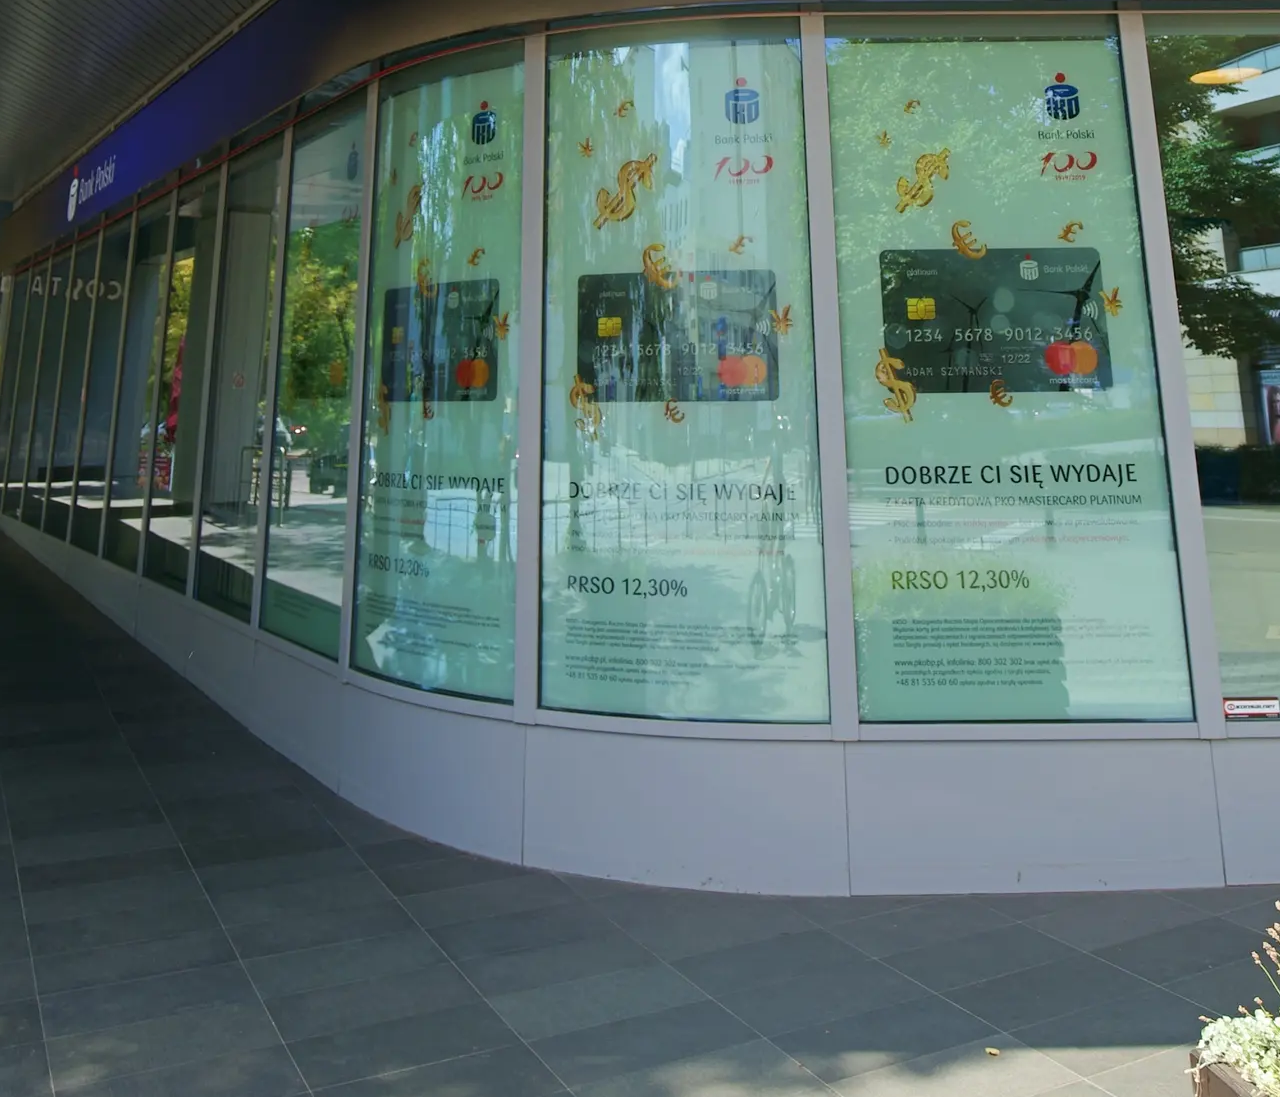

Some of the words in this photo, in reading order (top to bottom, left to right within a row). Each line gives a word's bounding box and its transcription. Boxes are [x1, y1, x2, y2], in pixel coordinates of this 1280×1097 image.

[714, 134, 741, 146] Bank
[743, 133, 773, 145] Polski
[1038, 129, 1064, 141] Bank
[1066, 129, 1095, 140] Polski
[713, 154, 774, 182] 100
[1040, 150, 1098, 177] 100
[905, 328, 944, 343] 1234
[954, 327, 994, 343] 5678
[1004, 327, 1043, 342] 9012
[1054, 326, 1093, 342] 3456
[1001, 353, 1032, 365] 12/22
[905, 366, 934, 378] ADAM
[940, 364, 1004, 377] SZYMAŃSKI
[1048, 376, 1098, 385] mastercard
[411, 474, 422, 490] CI
[885, 465, 973, 485] DOBRZE
[980, 464, 1001, 484] CI
[1009, 464, 1044, 489] SIĘ
[1049, 463, 1138, 488] WYDAJE
[568, 481, 642, 500] DOBRZE
[648, 482, 668, 500] CI
[675, 483, 708, 504] SIĘ
[714, 482, 798, 506] WYDAJE
[994, 496, 1016, 507] PKO
[1018, 495, 1087, 506] MASTERCARD
[1089, 494, 1143, 505] PLATINUM
[567, 575, 615, 595] RRSO
[621, 578, 689, 599] 12,30%
[891, 570, 949, 590] RRSO
[956, 569, 1030, 592] 12,30%
[977, 657, 992, 666] 800
[994, 657, 1007, 666] 302
[1009, 657, 1023, 665] 302
[922, 678, 936, 686] 535
[937, 678, 947, 686] 60
[948, 678, 959, 686] 60
